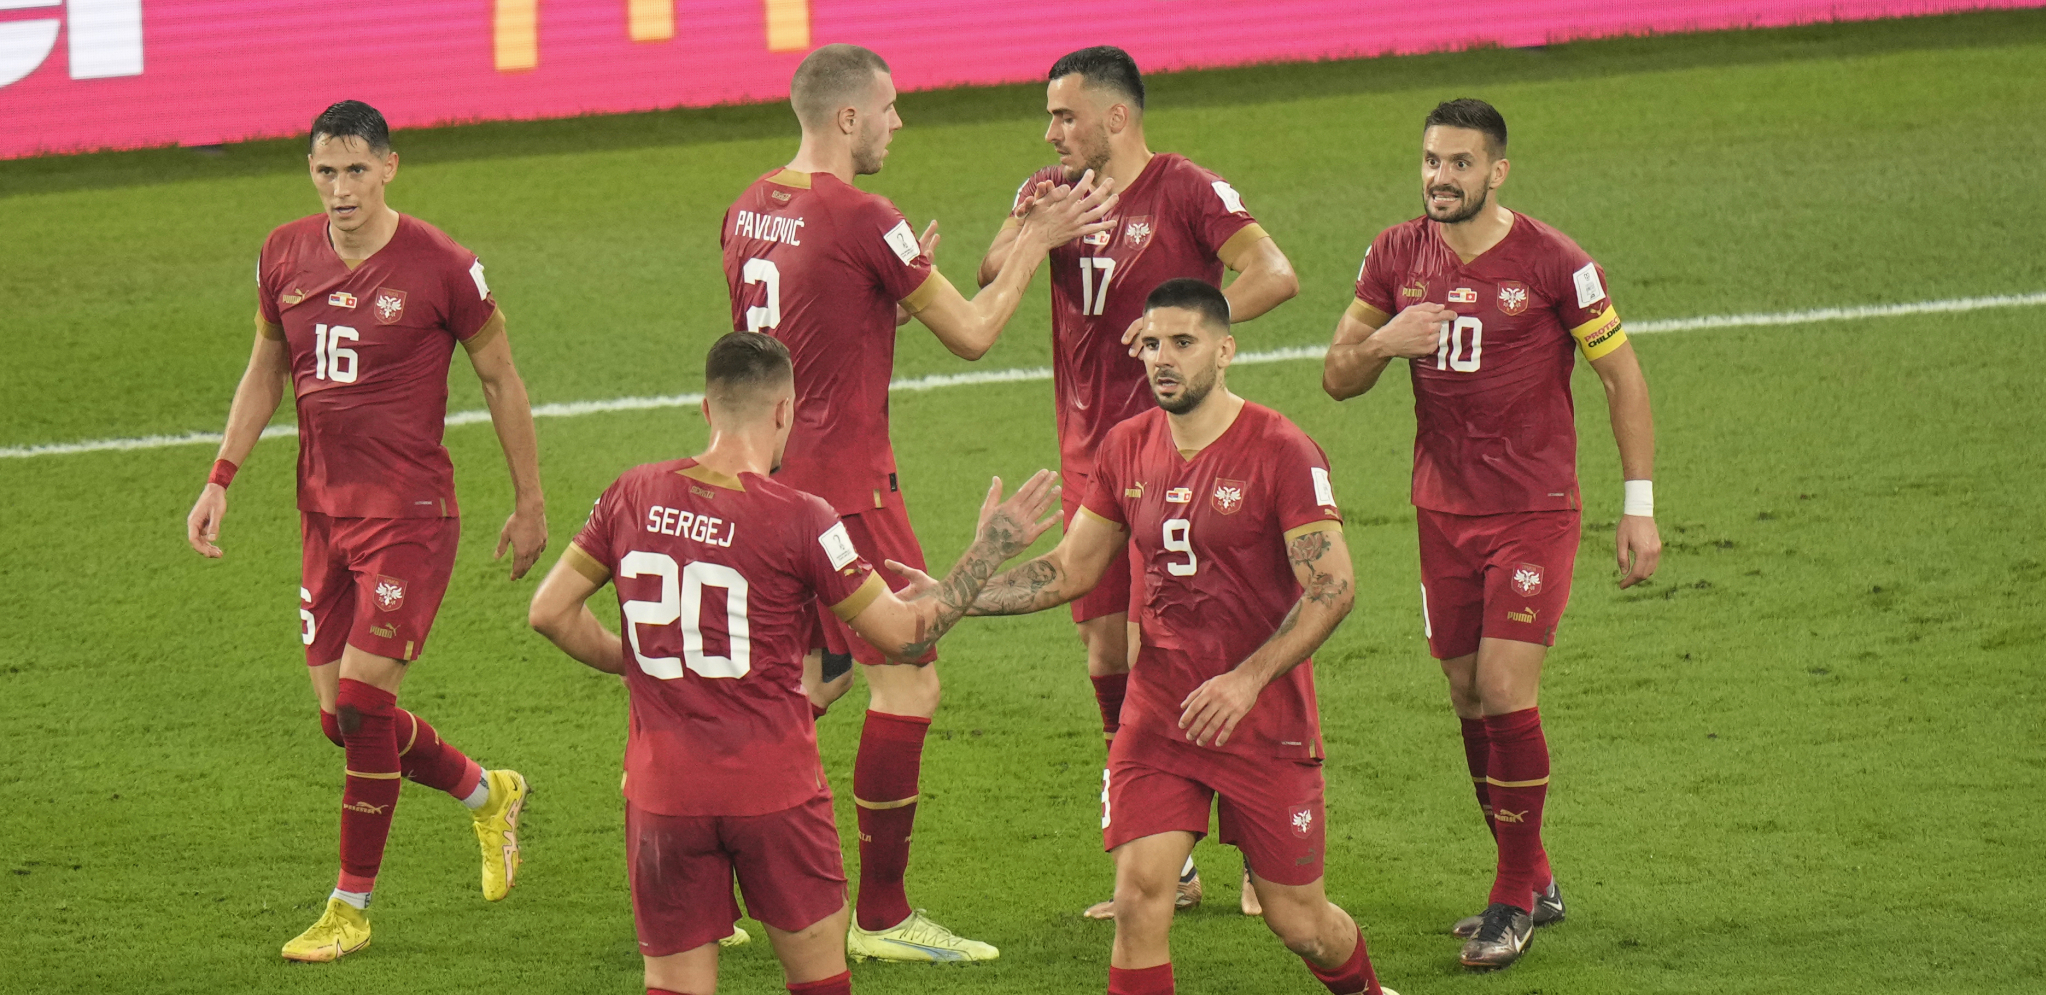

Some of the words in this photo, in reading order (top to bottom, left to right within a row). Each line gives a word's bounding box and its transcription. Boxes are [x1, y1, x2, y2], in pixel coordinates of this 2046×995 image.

[735, 210, 805, 246] PAVLOVIĆ
[1079, 257, 1117, 316] 17
[315, 323, 360, 383] 16
[1436, 316, 1483, 373] 10
[646, 505, 735, 547] SERGEJ
[1162, 518, 1198, 577] 9
[369, 625, 393, 639] PUMA
[620, 550, 751, 680] 20
[1507, 611, 1533, 624] PUMA
